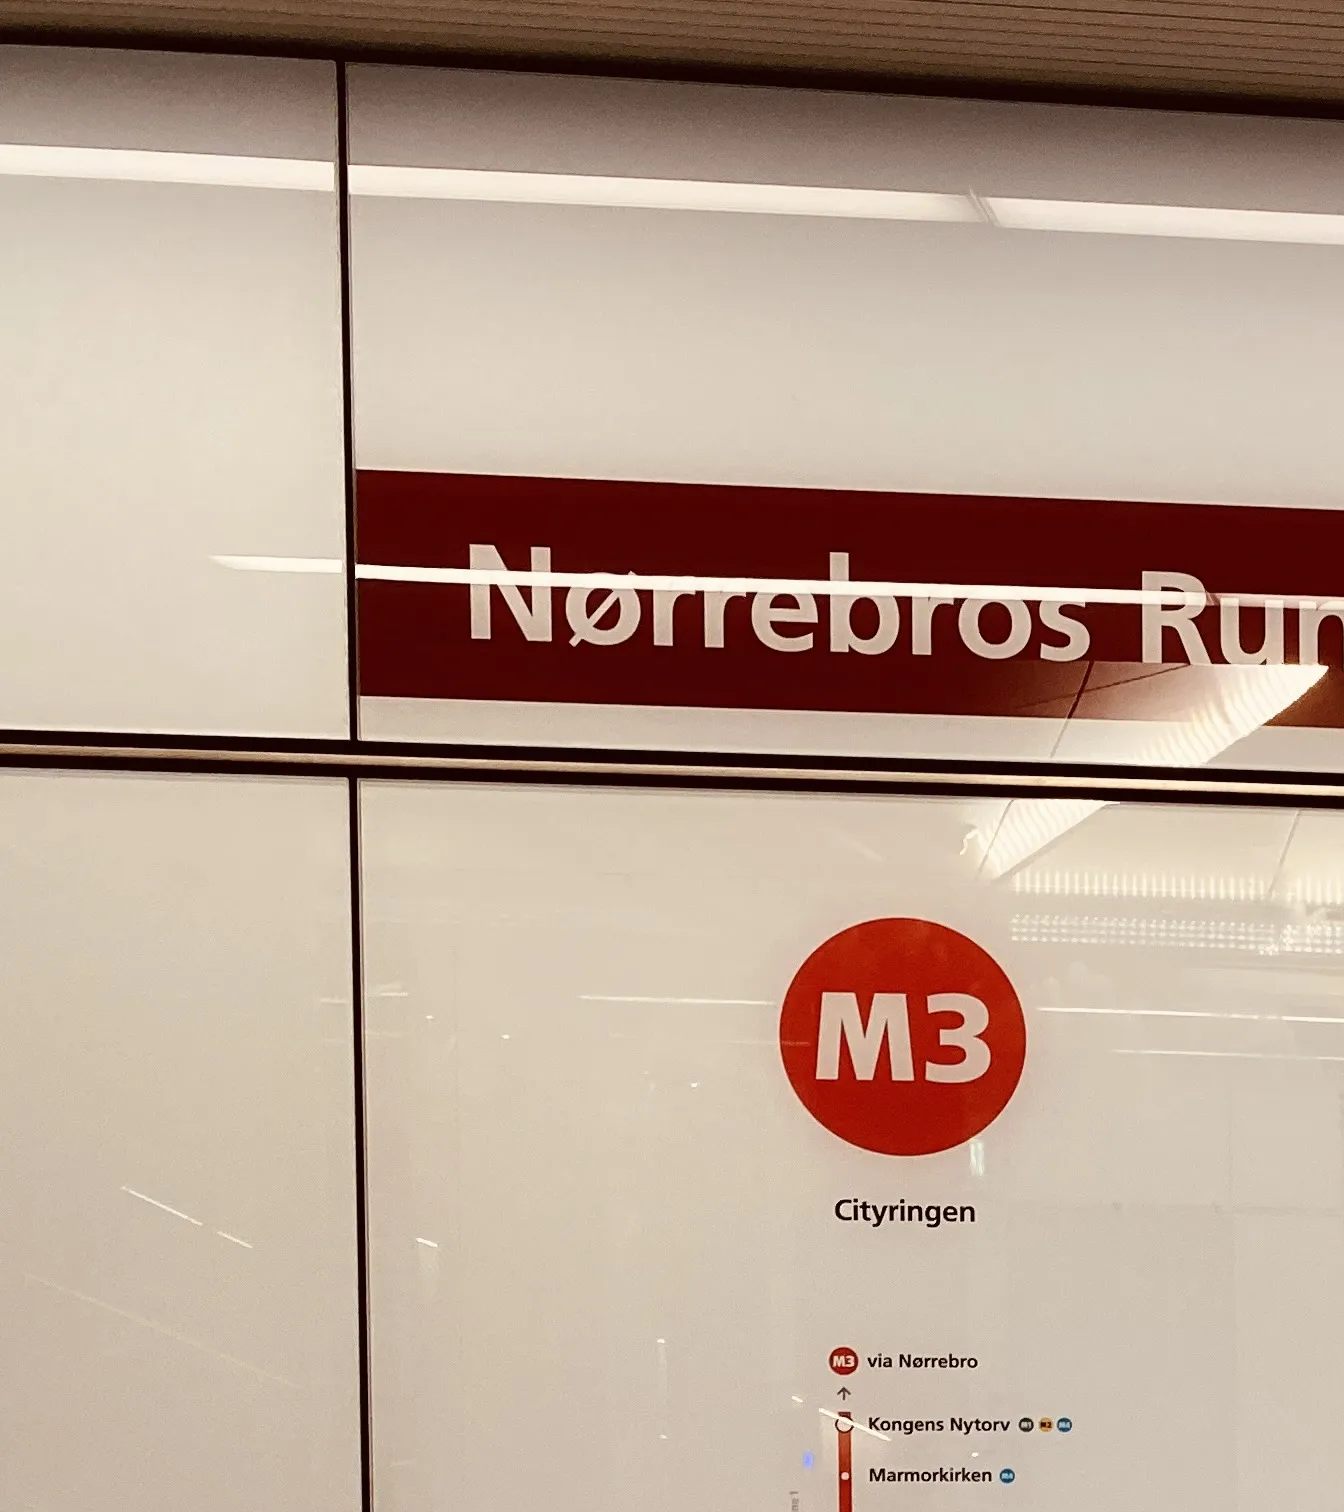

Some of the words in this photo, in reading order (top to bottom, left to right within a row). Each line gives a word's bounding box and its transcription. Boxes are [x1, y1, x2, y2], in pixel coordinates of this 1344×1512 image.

[468, 543, 1091, 666] Nørrebros
[815, 991, 992, 1084] M3
[835, 1198, 975, 1227] Cityringen
[832, 1354, 856, 1369] M3
[868, 1353, 892, 1367] via
[900, 1353, 978, 1368] Nørrebro
[868, 1417, 944, 1434] Kongens
[950, 1417, 1011, 1435] Nytorv
[870, 1467, 992, 1482] Marmorkirken
